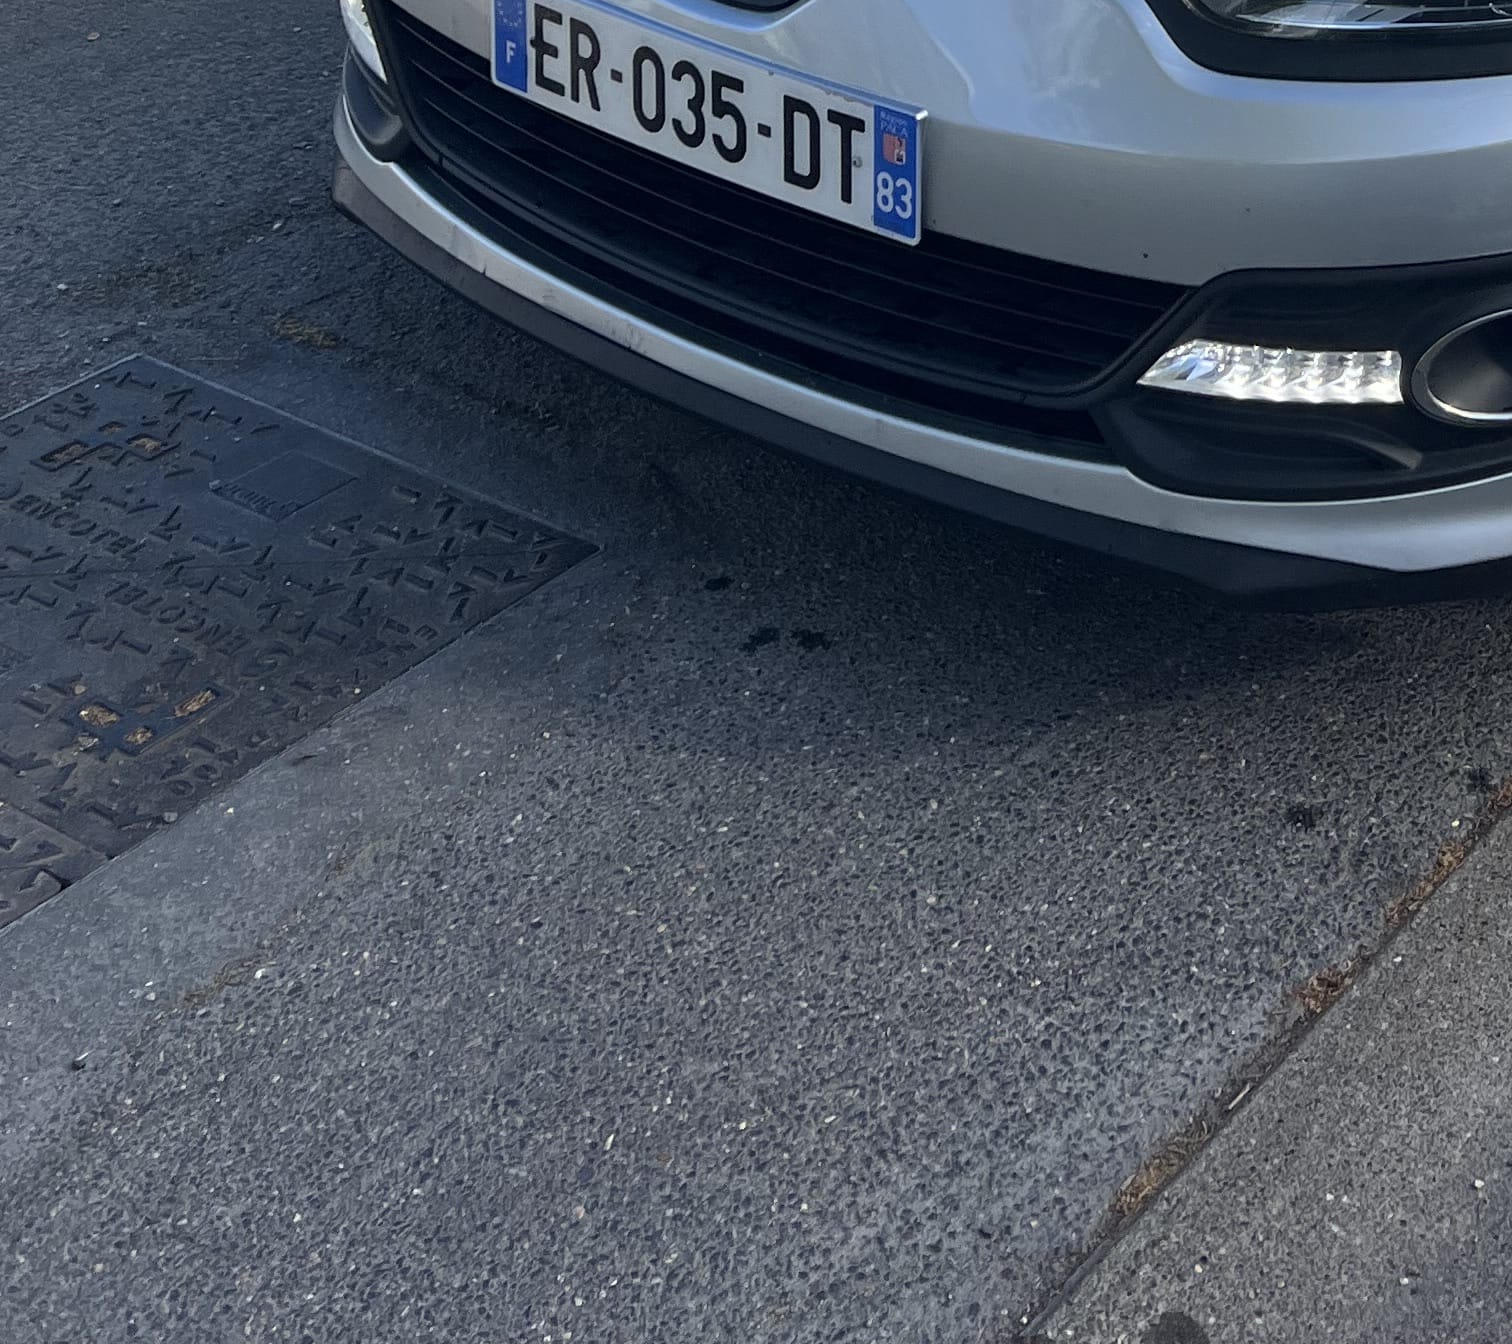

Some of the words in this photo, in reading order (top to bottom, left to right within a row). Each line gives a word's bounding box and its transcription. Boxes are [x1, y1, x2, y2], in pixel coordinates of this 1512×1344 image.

[505, 39, 517, 65] F
[530, 2, 866, 205] ER-035-DT
[876, 171, 913, 220] 83
